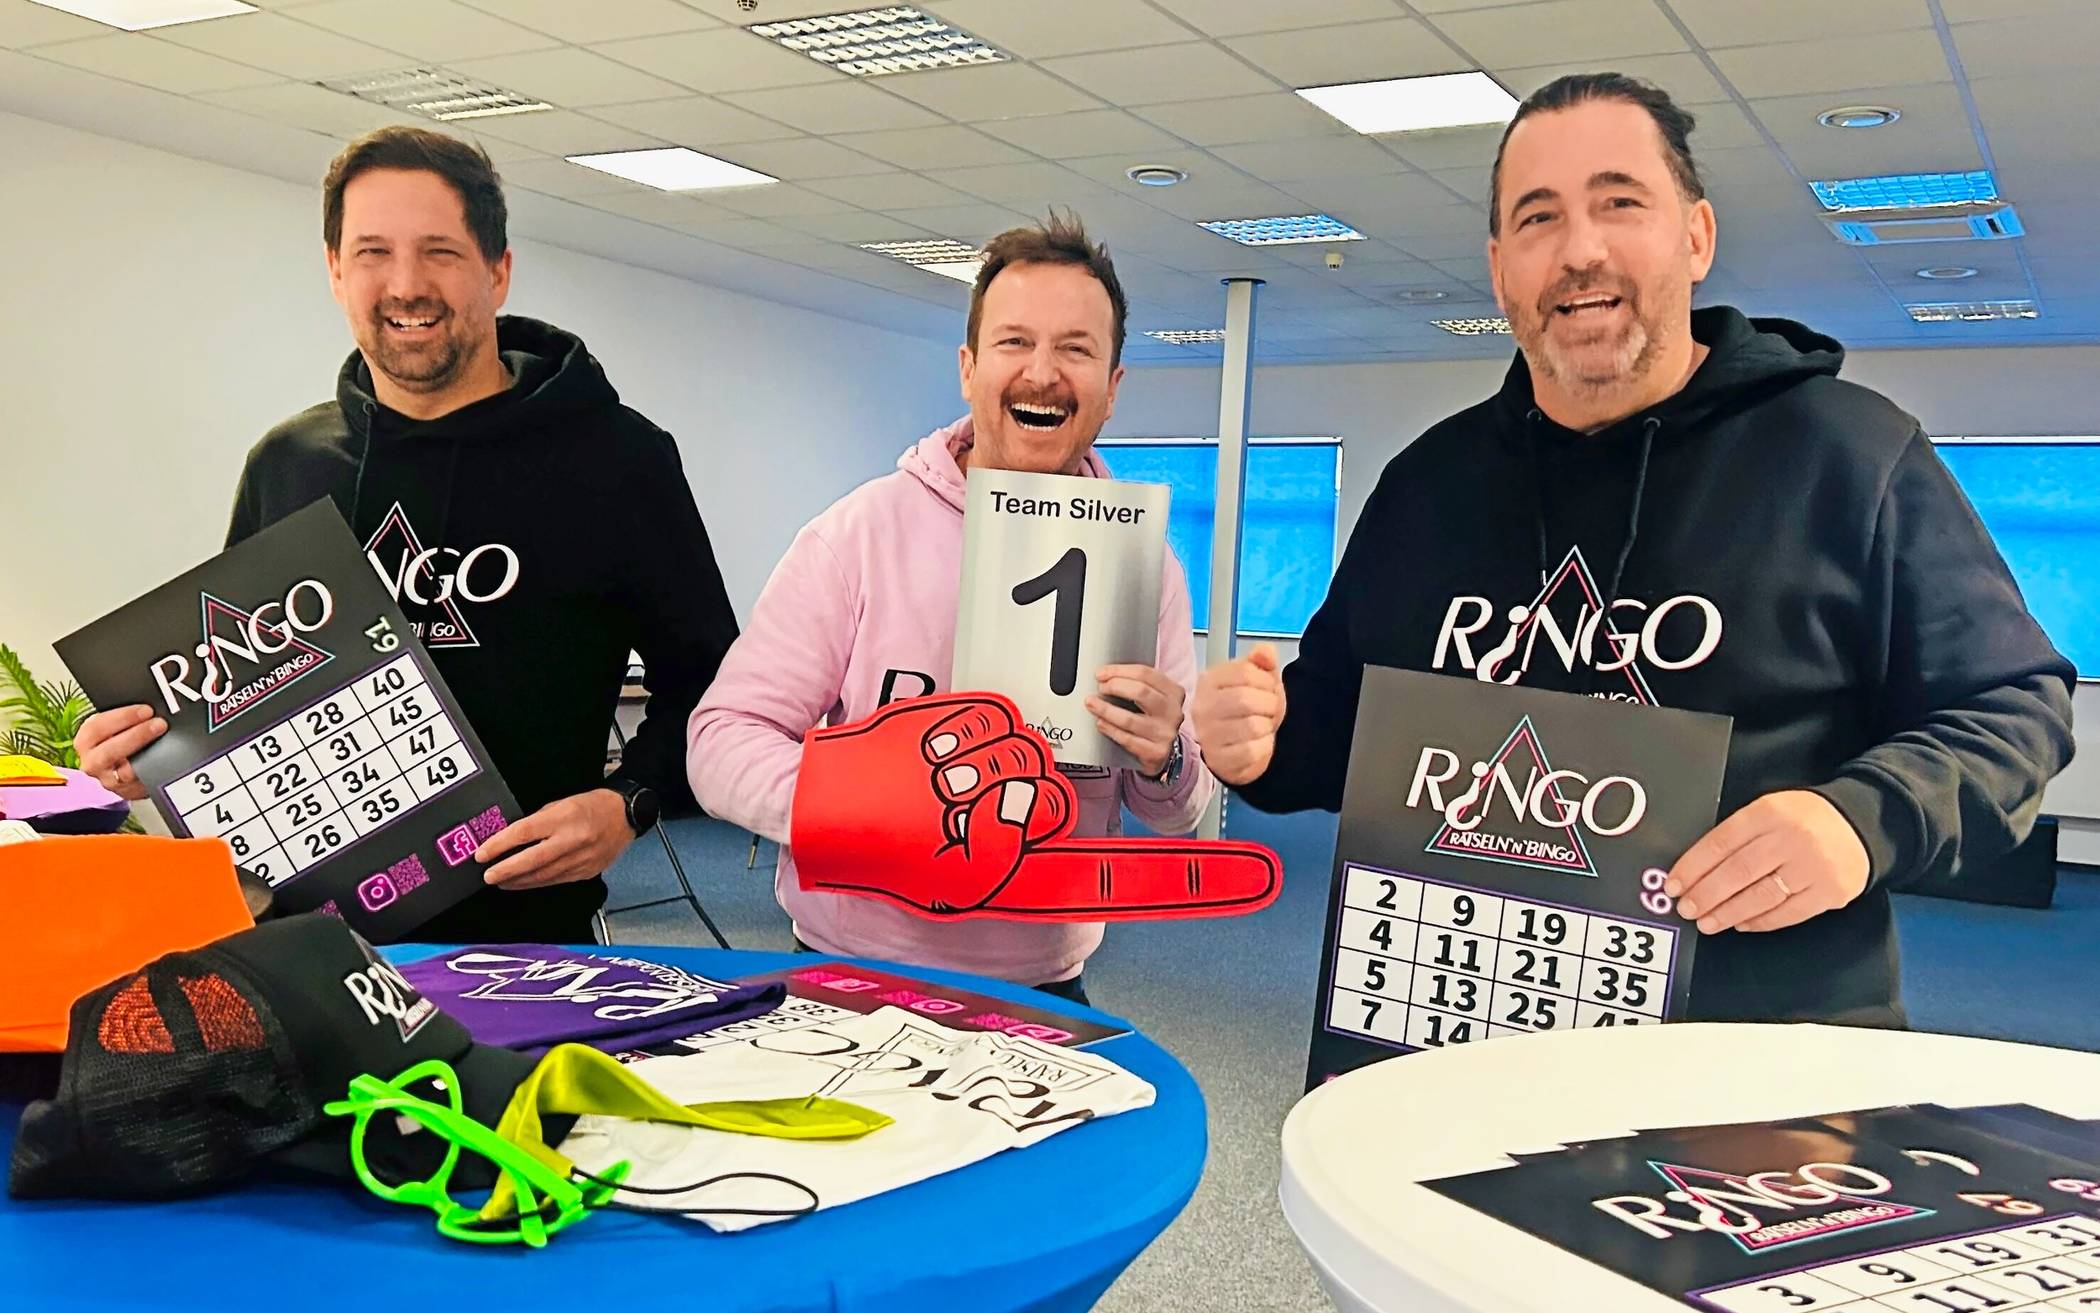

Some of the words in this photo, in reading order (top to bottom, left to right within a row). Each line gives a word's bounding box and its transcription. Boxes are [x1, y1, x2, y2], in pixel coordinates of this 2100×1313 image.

[990, 490, 1061, 518] Team
[1069, 498, 1146, 525] Silver
[1011, 547, 1088, 697] 1
[194, 772, 215, 795] 3
[249, 735, 282, 764] 13
[306, 701, 344, 736] 28
[372, 667, 405, 697] 40
[215, 803, 234, 824] 4
[266, 763, 307, 798] 22
[329, 731, 362, 761] 31
[389, 695, 423, 727] 45
[230, 834, 250, 857] 8
[285, 792, 322, 827] 25
[342, 762, 381, 794] 34
[409, 724, 435, 756] 47
[254, 862, 276, 889] 2
[304, 824, 342, 859] 26
[361, 788, 400, 823] 35
[426, 756, 459, 787] 49
[1369, 919, 1393, 952] 4
[1433, 933, 1481, 973] 11
[1511, 949, 1561, 990] 21
[1592, 966, 1649, 1007] 35
[1376, 879, 1397, 911] 2
[1451, 894, 1475, 927] 9
[1516, 908, 1567, 946] 19
[1602, 925, 1655, 964] 33
[1361, 998, 1382, 1031] 7
[1423, 1015, 1472, 1048] 14
[1363, 958, 1387, 991] 5
[1428, 974, 1477, 1013] 13
[1506, 991, 1557, 1031] 25
[1592, 1011, 1640, 1028] 4
[1758, 1285, 1816, 1306] 3
[1859, 1263, 1917, 1283] 9
[1938, 1242, 2021, 1267] 19
[2026, 1224, 2100, 1247] 31
[1912, 1286, 2009, 1313] 11
[2004, 1265, 2099, 1292] 21
